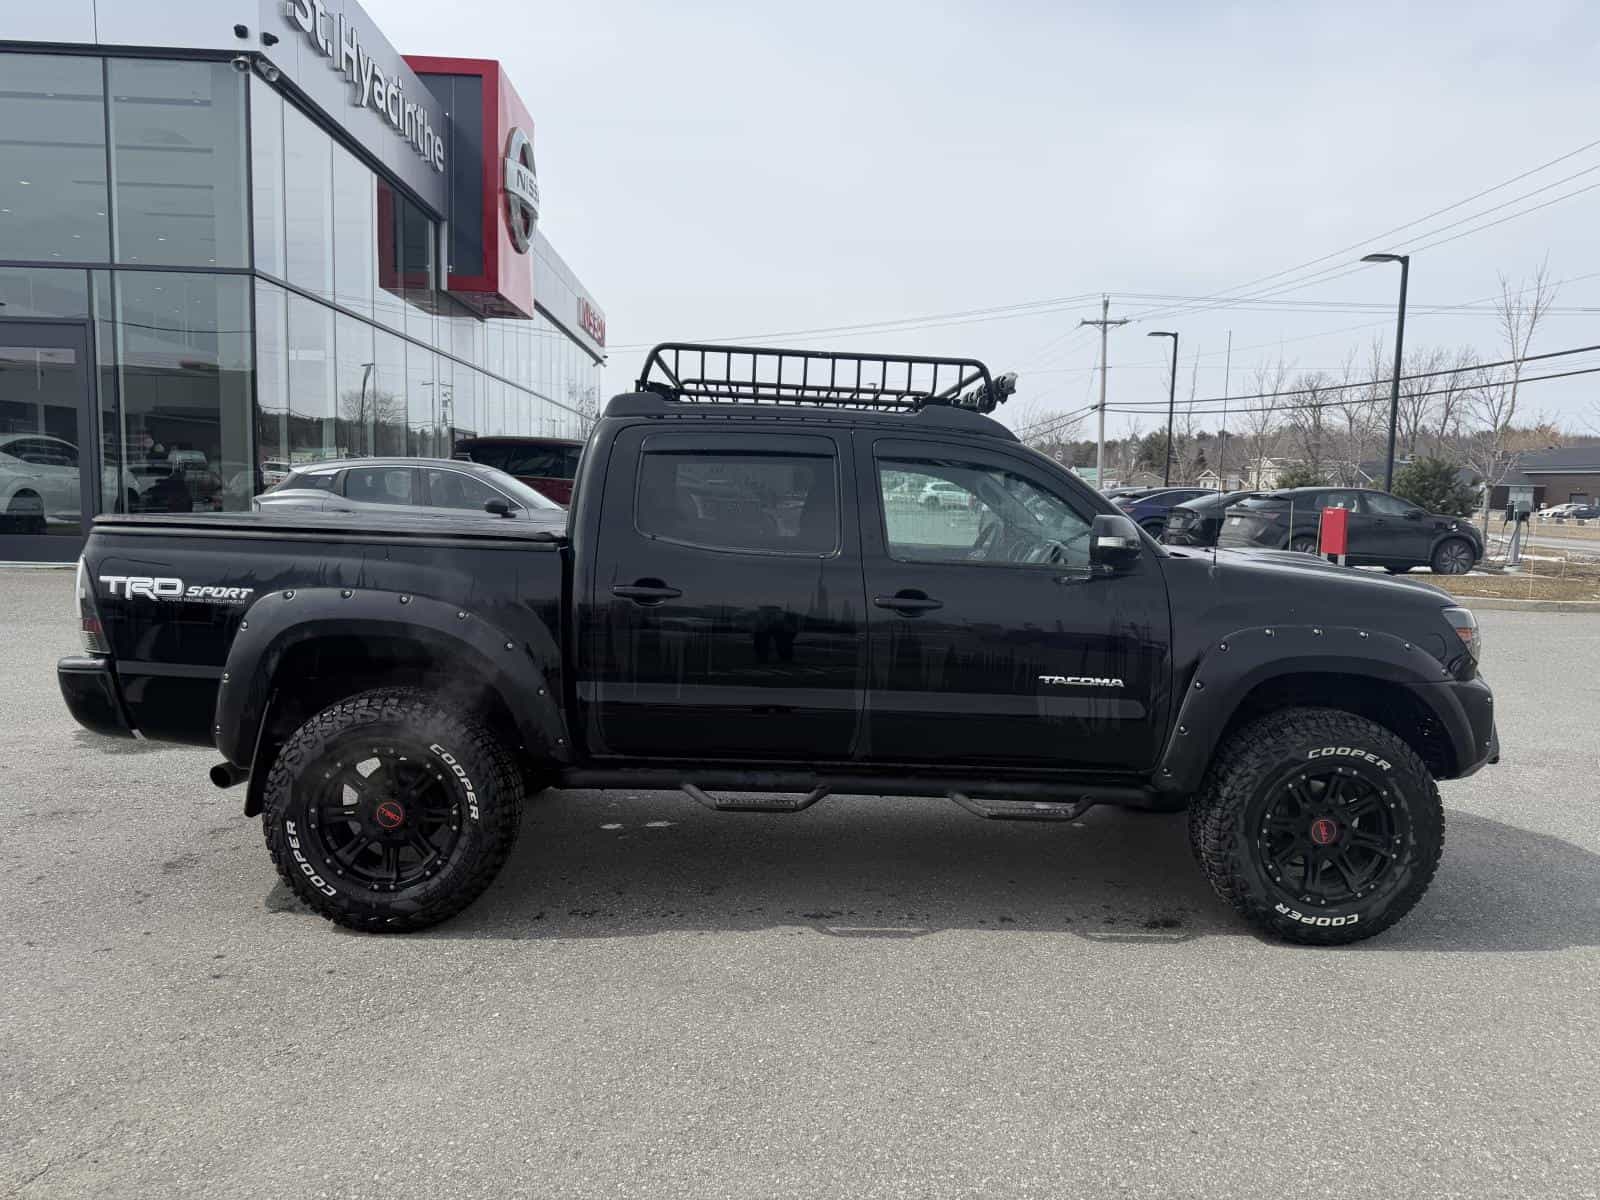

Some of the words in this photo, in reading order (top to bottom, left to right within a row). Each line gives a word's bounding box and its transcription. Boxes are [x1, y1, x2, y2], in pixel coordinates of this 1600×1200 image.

[335, 13, 444, 172] Hyacinthe
[99, 575, 184, 601] TRD
[185, 586, 254, 600] SPORT
[1038, 675, 1125, 688] TACOMA
[1308, 747, 1392, 772] COOPER
[430, 743, 480, 821] COOPER
[286, 820, 337, 897] COOPER
[1275, 903, 1359, 927] COOPER
